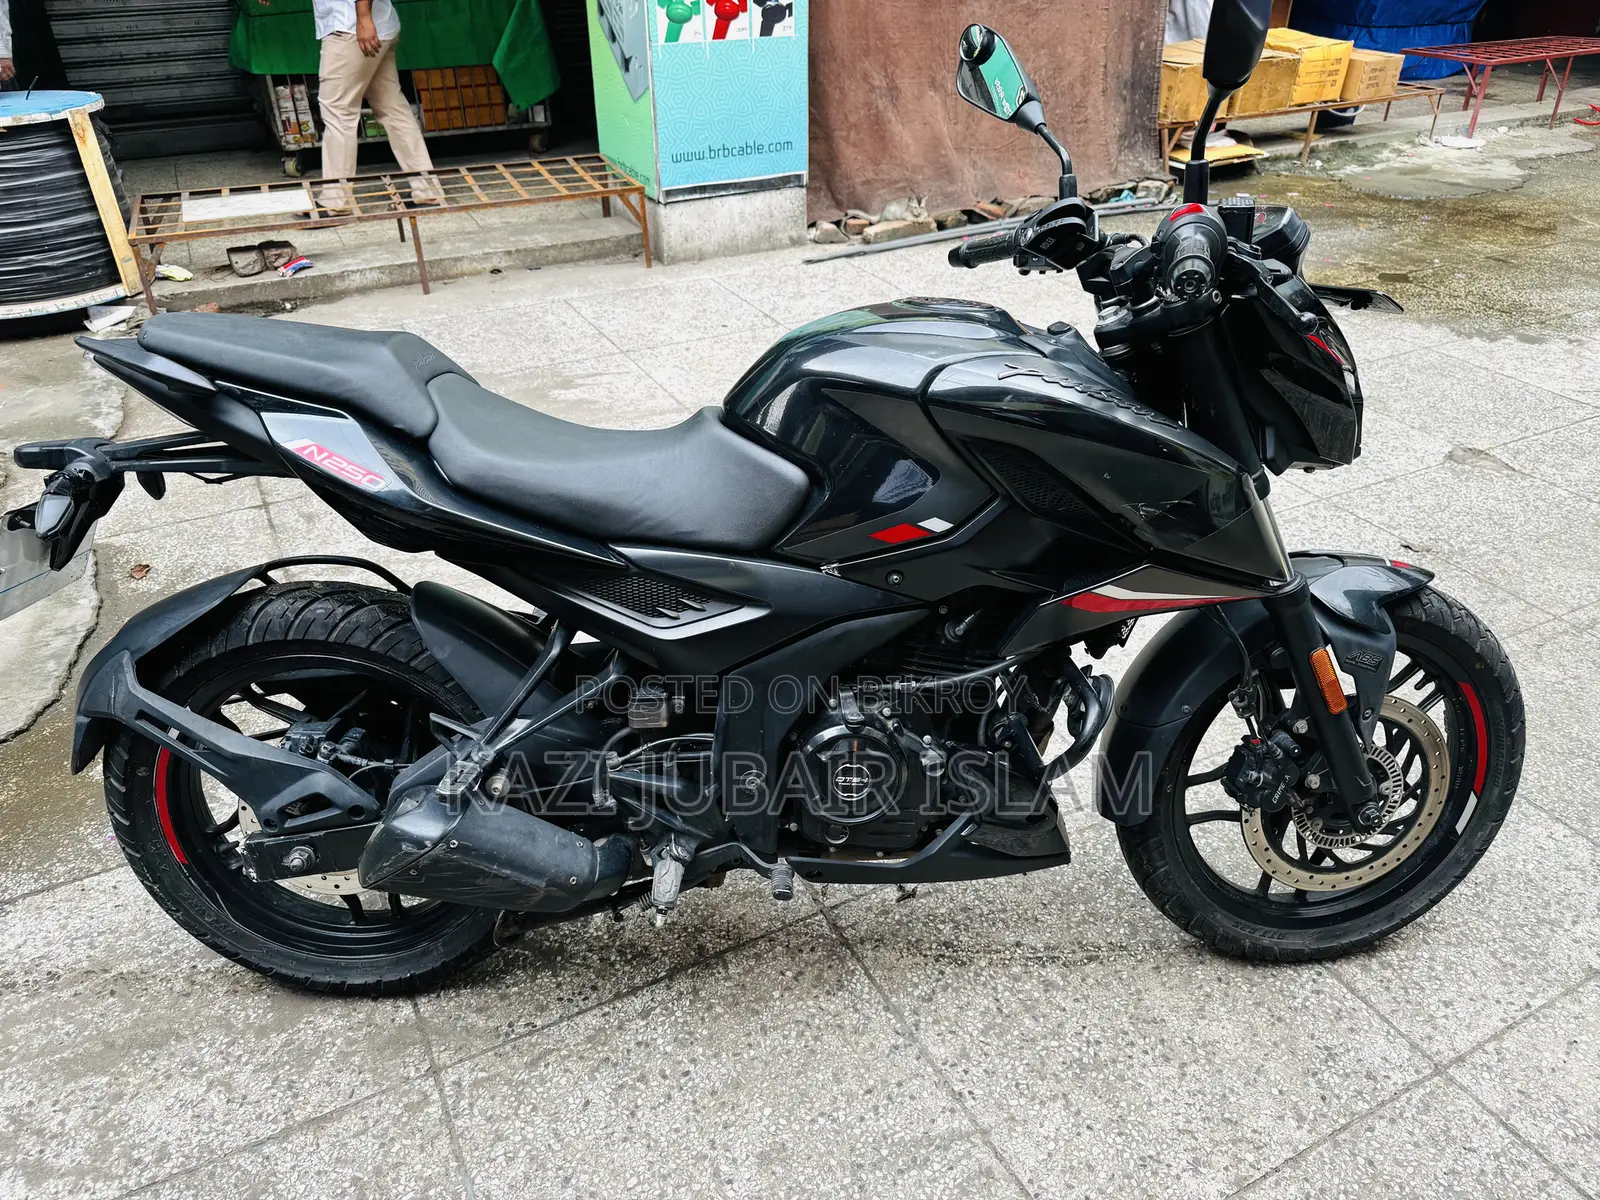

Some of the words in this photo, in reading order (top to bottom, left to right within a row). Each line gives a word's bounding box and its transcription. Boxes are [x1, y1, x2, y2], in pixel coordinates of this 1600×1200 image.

[671, 140, 794, 164] www.brbcable.com
[302, 445, 386, 492] N250
[1345, 650, 1384, 667] ABS
